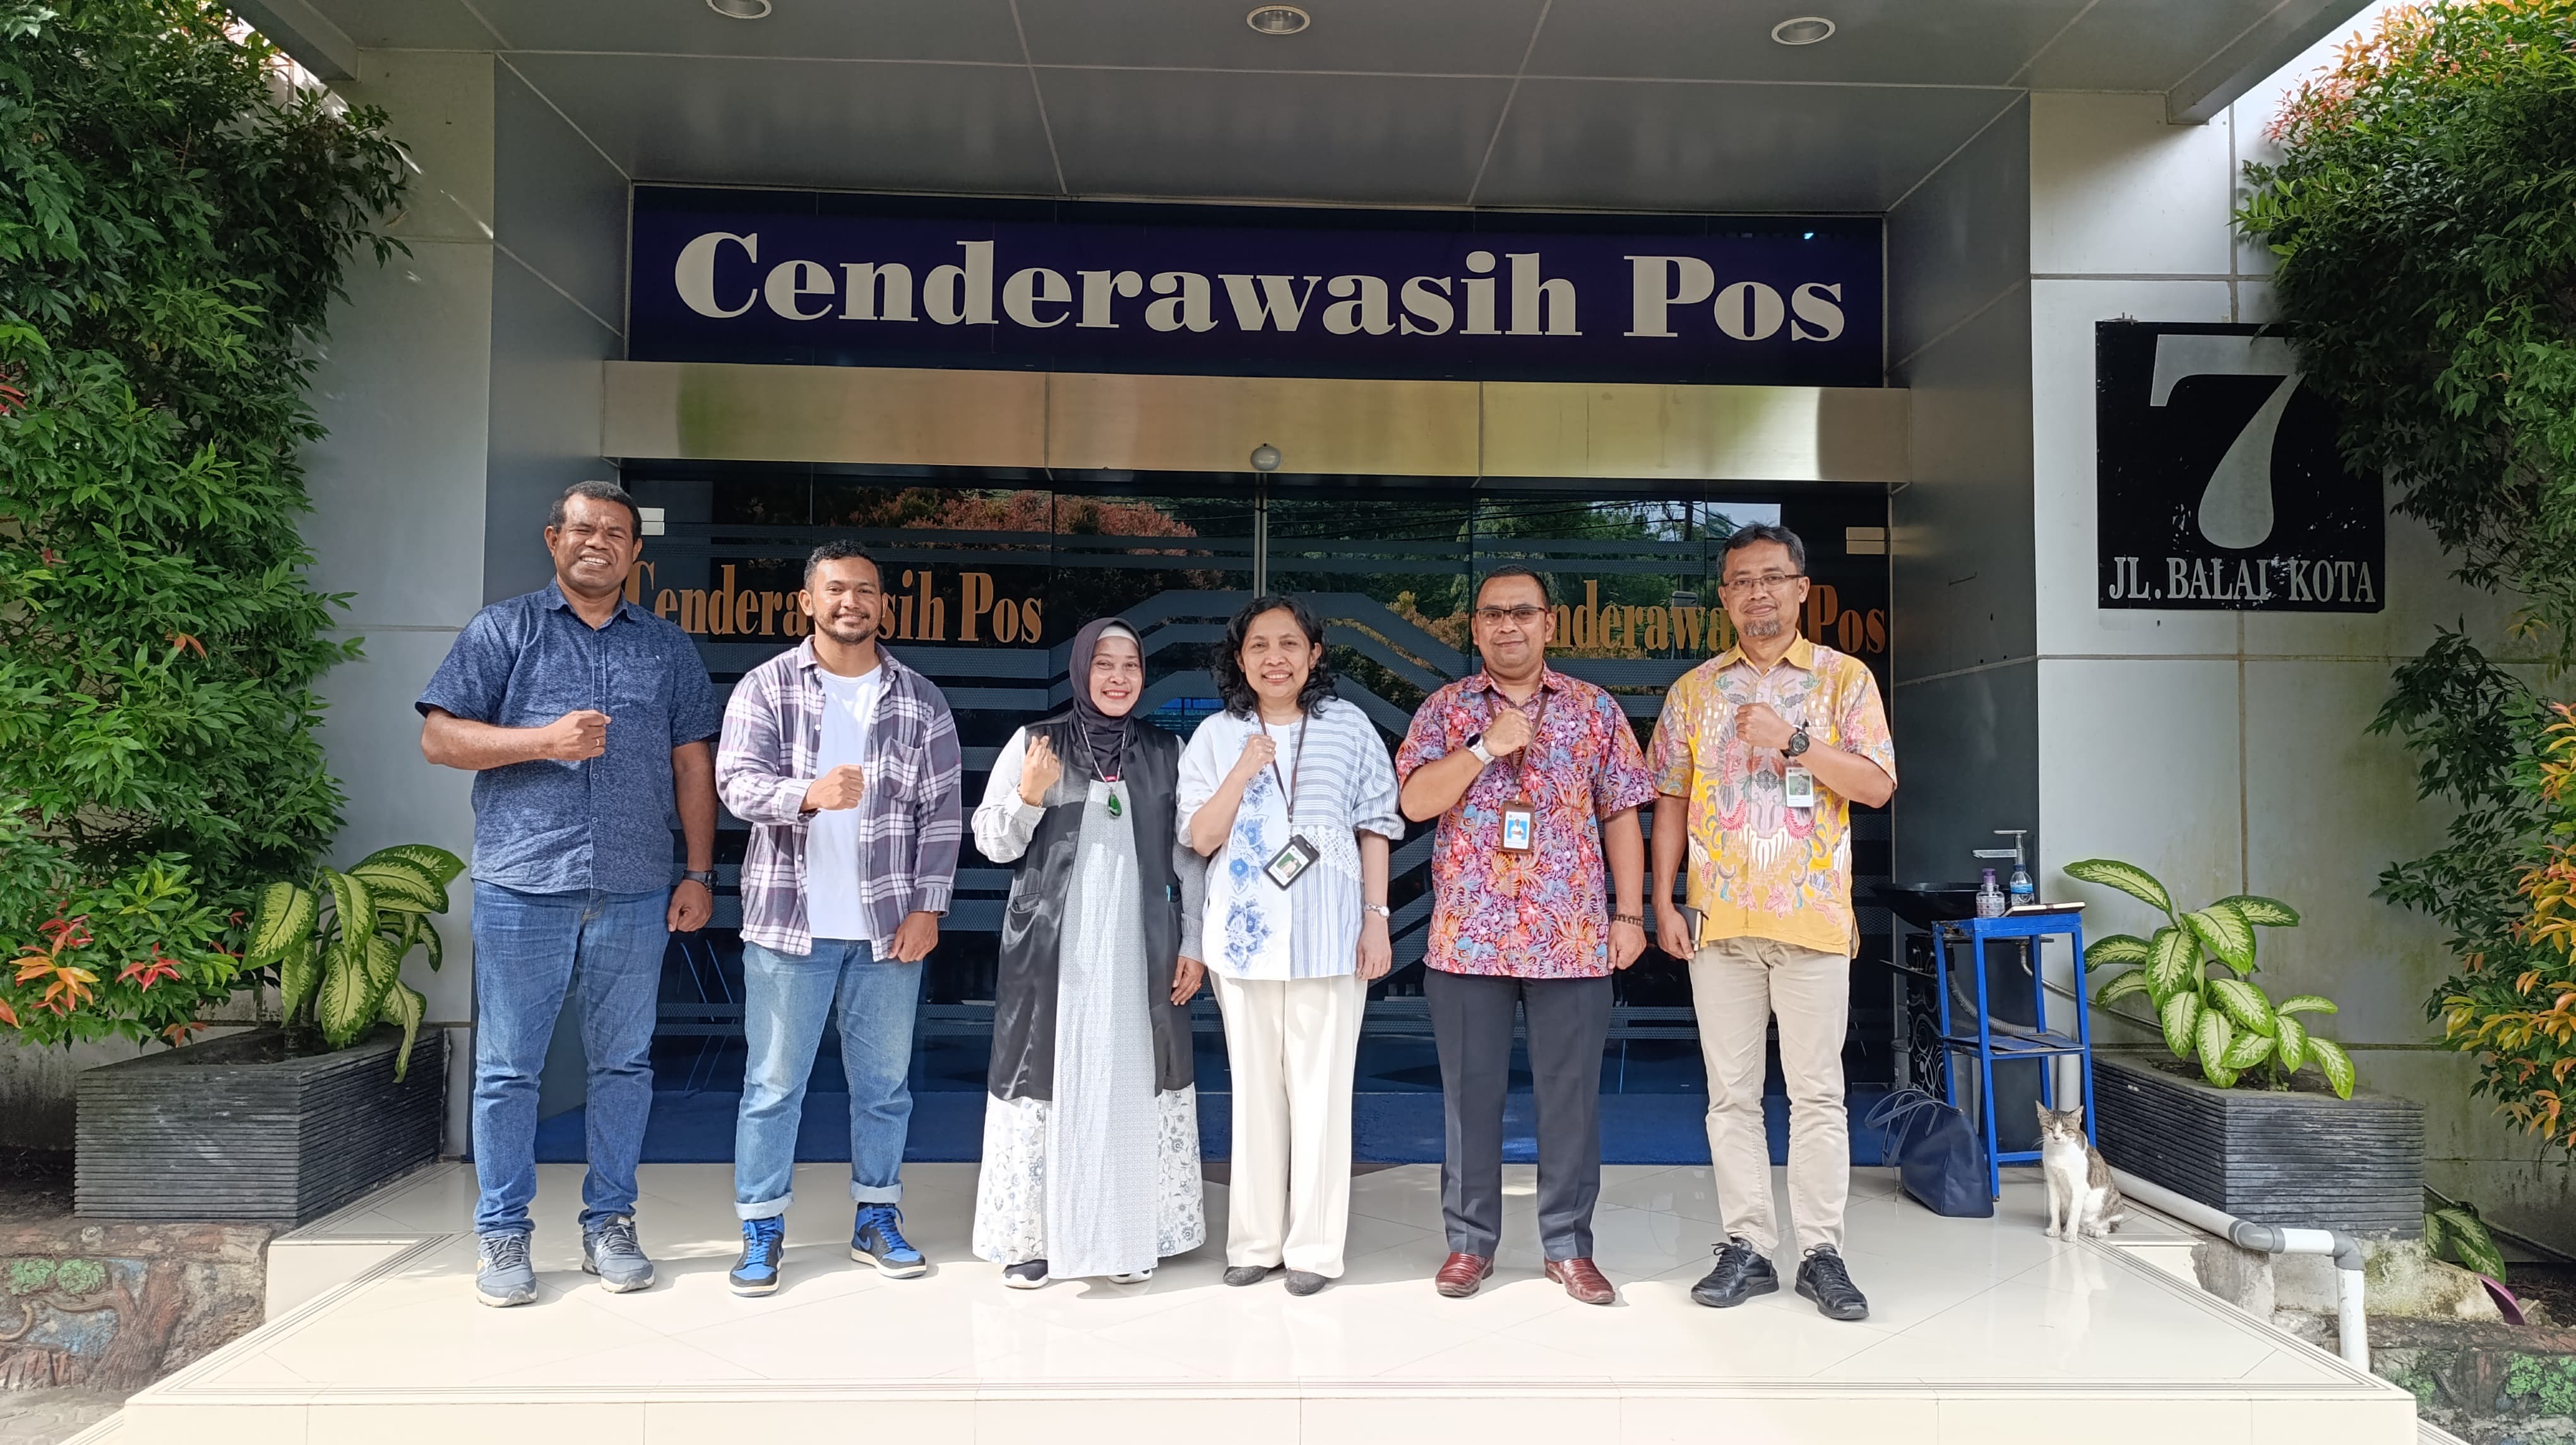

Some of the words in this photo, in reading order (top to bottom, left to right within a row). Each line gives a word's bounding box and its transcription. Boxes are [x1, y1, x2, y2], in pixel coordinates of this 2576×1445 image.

[674, 231, 1583, 337] Cenderawasih
[1623, 255, 1845, 342] Pos
[2149, 333, 2307, 549] 7
[623, 560, 946, 641] Cenderasih
[957, 572, 1042, 644] Pos
[1806, 584, 1887, 654] Pos
[2166, 557, 2271, 601] BALAI
[2288, 560, 2376, 603] KOTA
